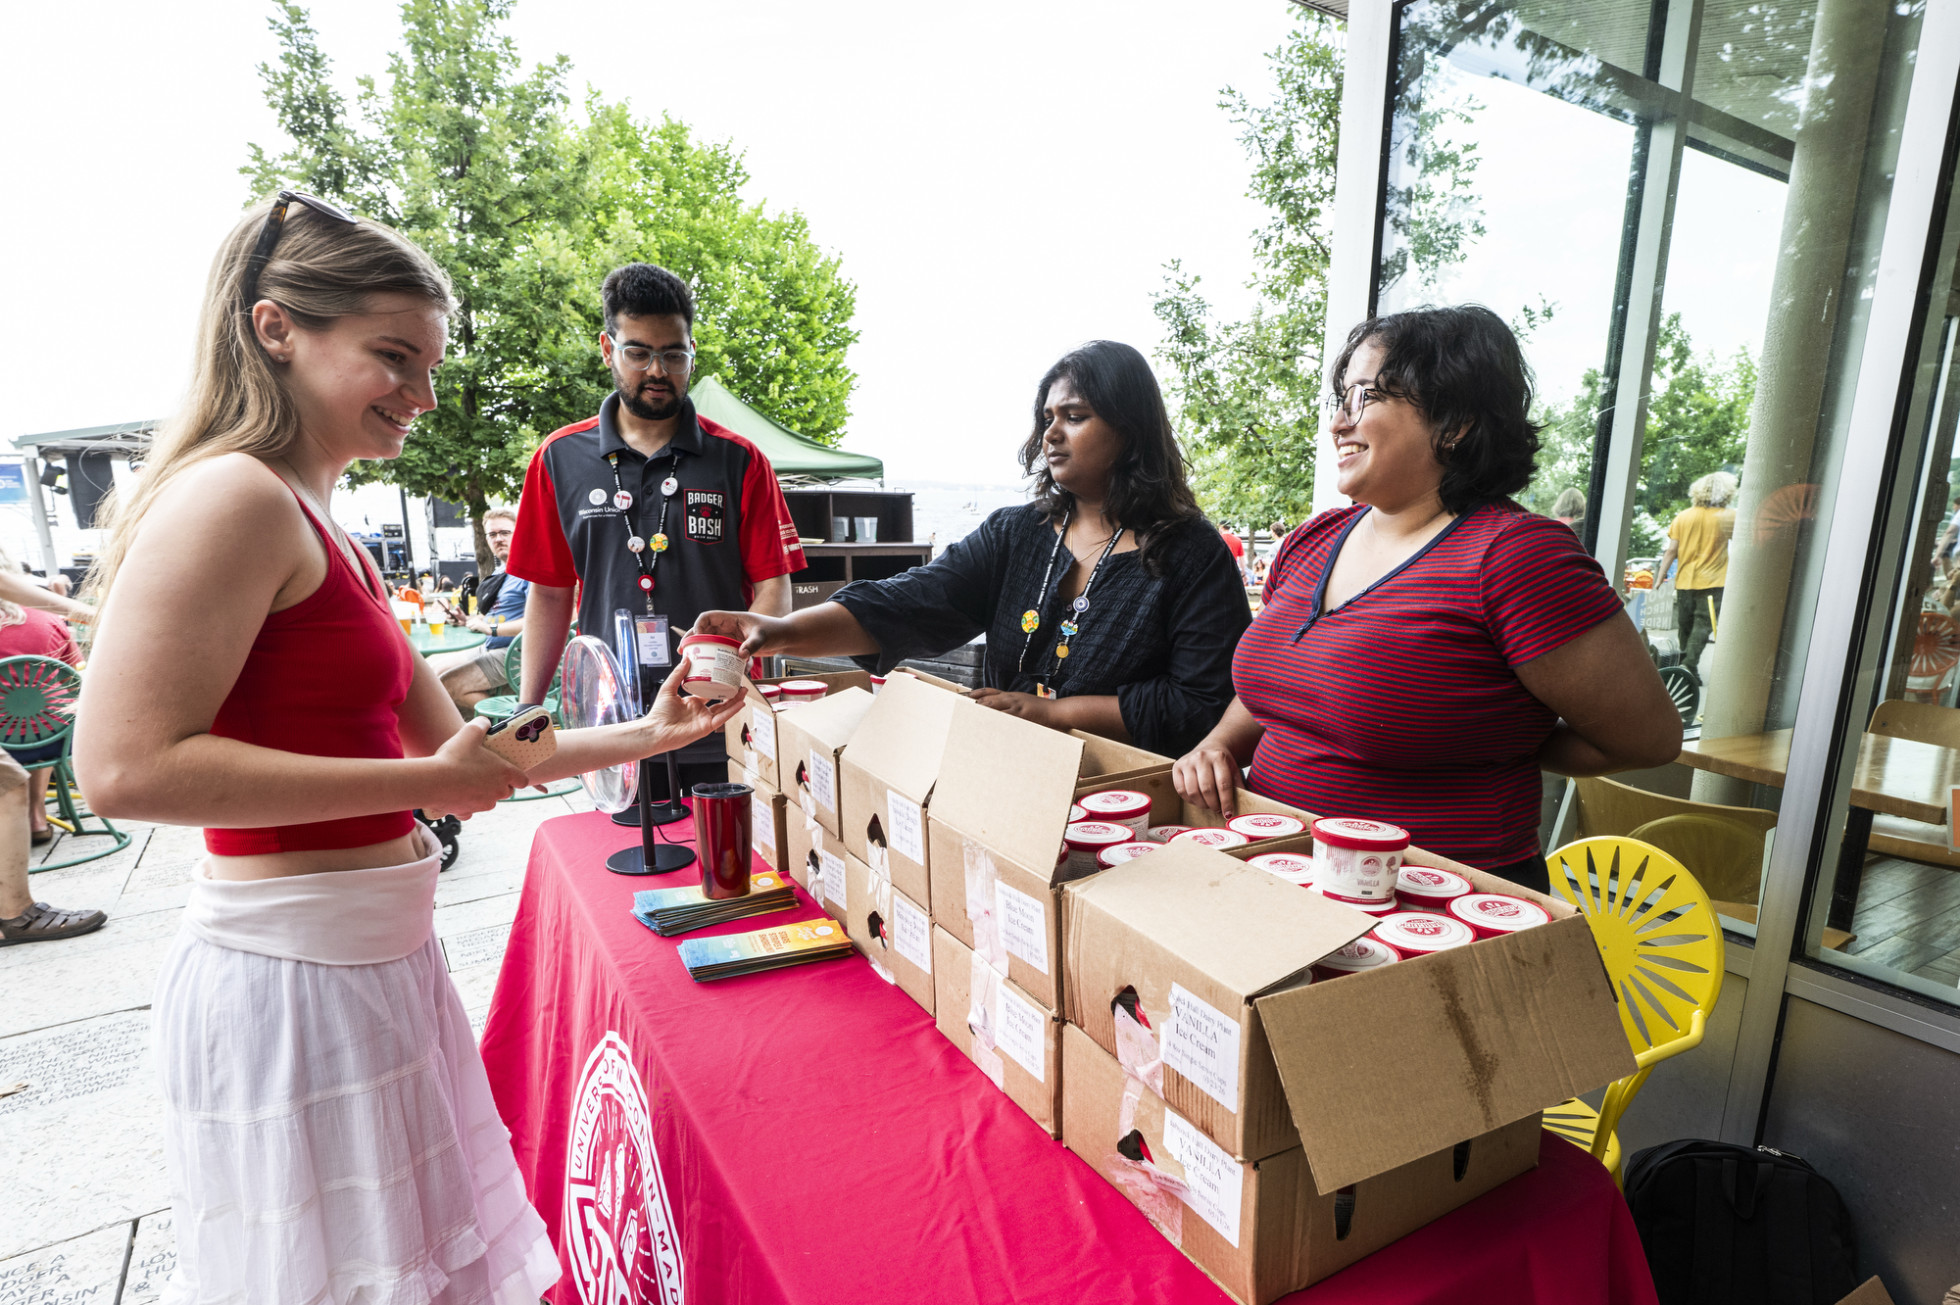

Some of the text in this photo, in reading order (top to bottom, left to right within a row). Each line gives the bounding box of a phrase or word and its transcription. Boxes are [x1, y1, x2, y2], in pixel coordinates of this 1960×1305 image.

[688, 492, 723, 508] BADGER
[688, 515, 722, 536] BASH
[795, 586, 818, 594] TRASH
[1176, 1006, 1218, 1044] VANILLA
[1176, 1023, 1188, 1040] Ice
[1190, 1032, 1216, 1060] Cream
[23, 1057, 78, 1074] RANDY
[41, 1065, 92, 1081] JASON
[63, 1065, 140, 1087] FARMERS
[1, 1073, 128, 1109] TOM OSOWSKI
[39, 1080, 125, 1106] LEARNING
[1180, 1138, 1221, 1180] VANILLA
[1193, 1166, 1219, 1194] Cream
[50, 1254, 66, 1264] A
[0, 1264, 63, 1291] DGER
[0, 1274, 71, 1300] AYS A
[134, 1282, 150, 1293] &
